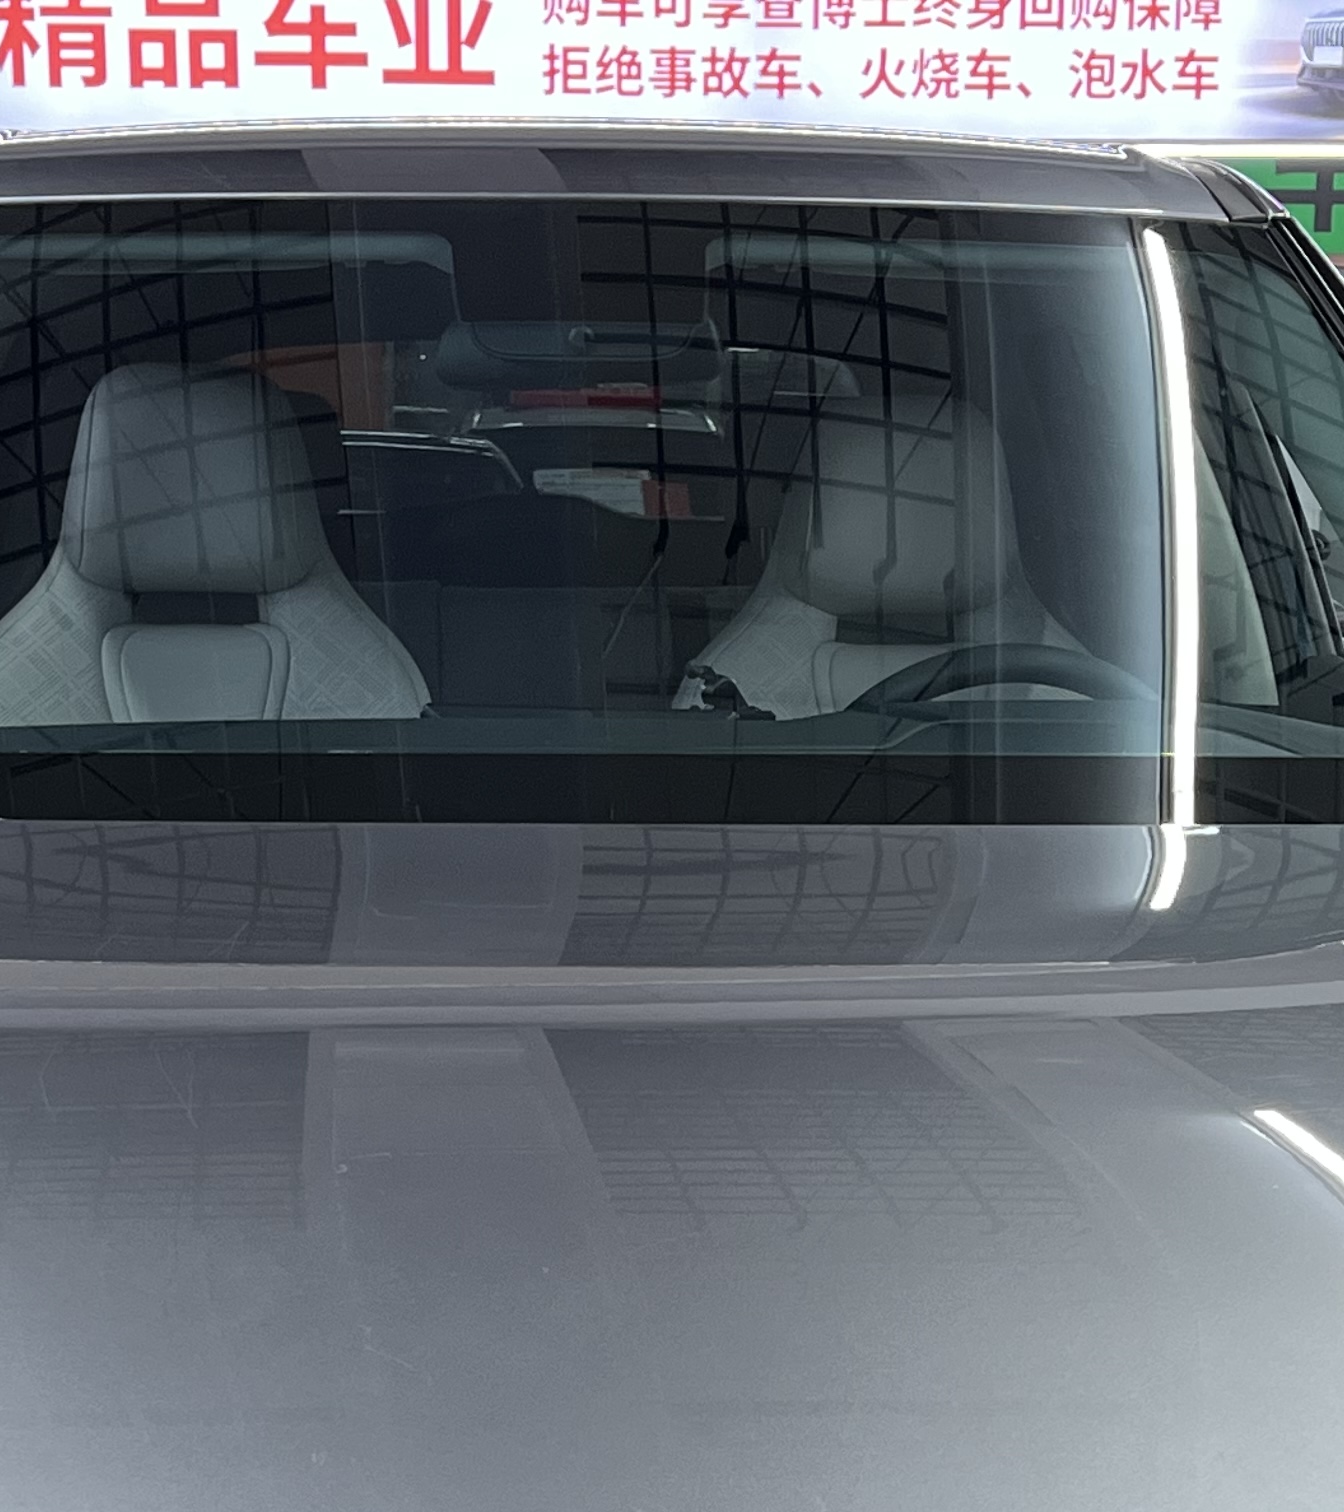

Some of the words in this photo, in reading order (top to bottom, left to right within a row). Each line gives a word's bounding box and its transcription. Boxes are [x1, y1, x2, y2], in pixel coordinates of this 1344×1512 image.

[542, 43, 1219, 101] 拒绝事故车、火烧车、泡水车
